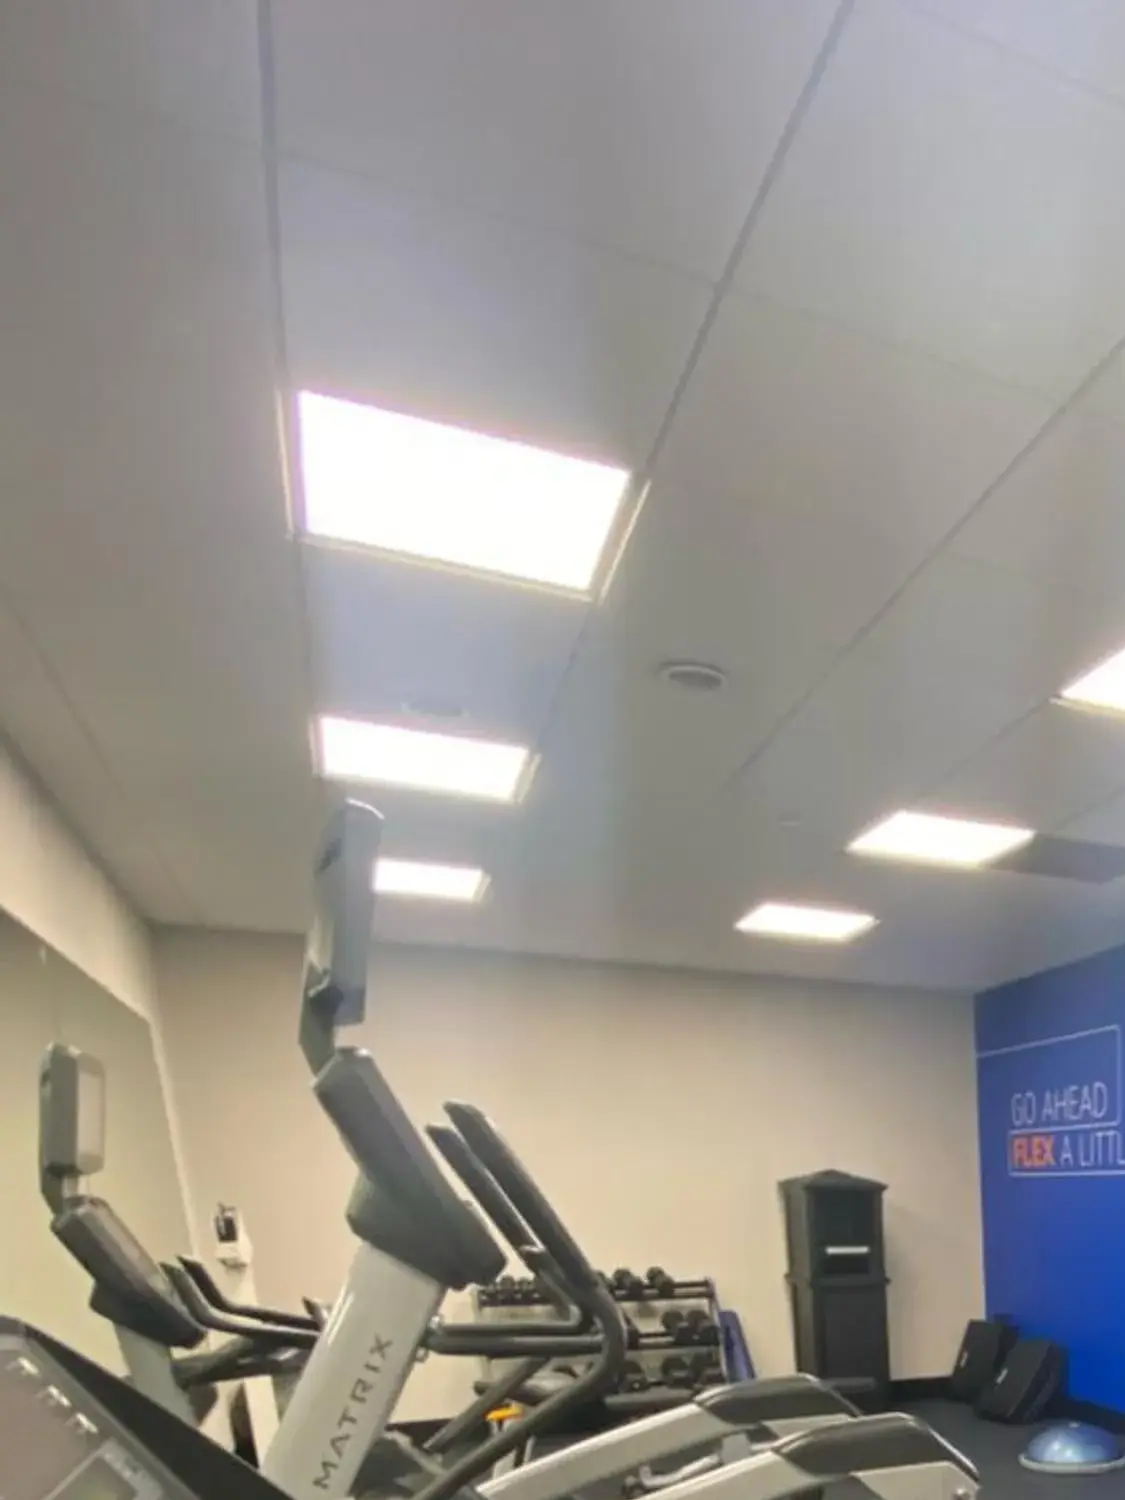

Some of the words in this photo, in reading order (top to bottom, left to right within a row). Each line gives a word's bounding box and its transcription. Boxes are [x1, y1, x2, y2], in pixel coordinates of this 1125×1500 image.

[1010, 1091, 1036, 1127] GO
[1041, 1081, 1108, 1122] AHEAD
[1011, 1134, 1056, 1168] FLEX
[1060, 1135, 1074, 1167] A
[312, 1334, 394, 1489] MATRIX
